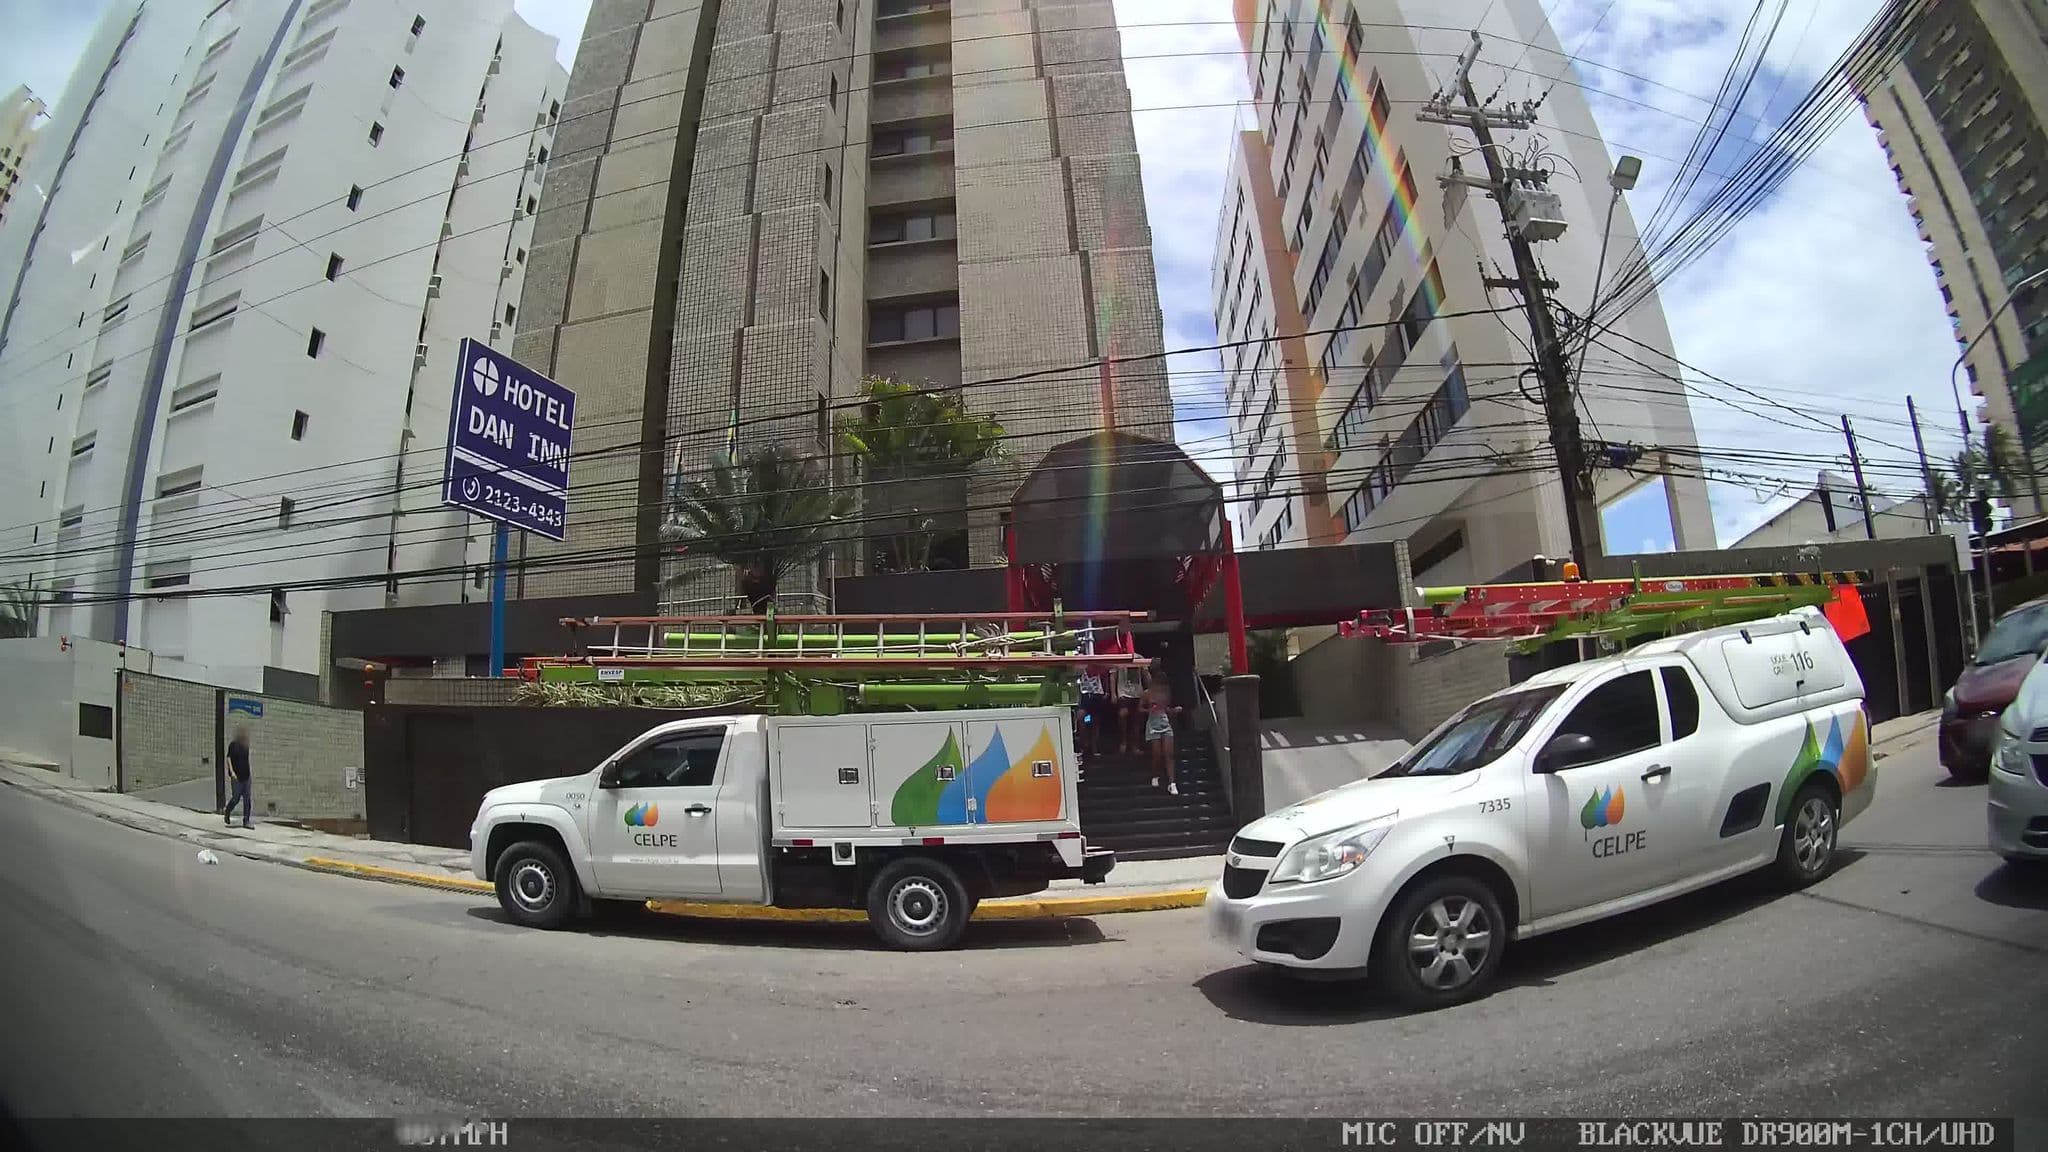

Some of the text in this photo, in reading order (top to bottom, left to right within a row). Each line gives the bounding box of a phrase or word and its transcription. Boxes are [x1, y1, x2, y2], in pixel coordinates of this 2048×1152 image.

[504, 375, 569, 430] HOTEL
[468, 405, 567, 473] DAN INN
[484, 485, 562, 527] 2123-4343
[1790, 651, 1814, 671] 116
[1479, 798, 1511, 814] 7335
[634, 833, 678, 848] CELPE
[1592, 830, 1647, 858] CELPE
